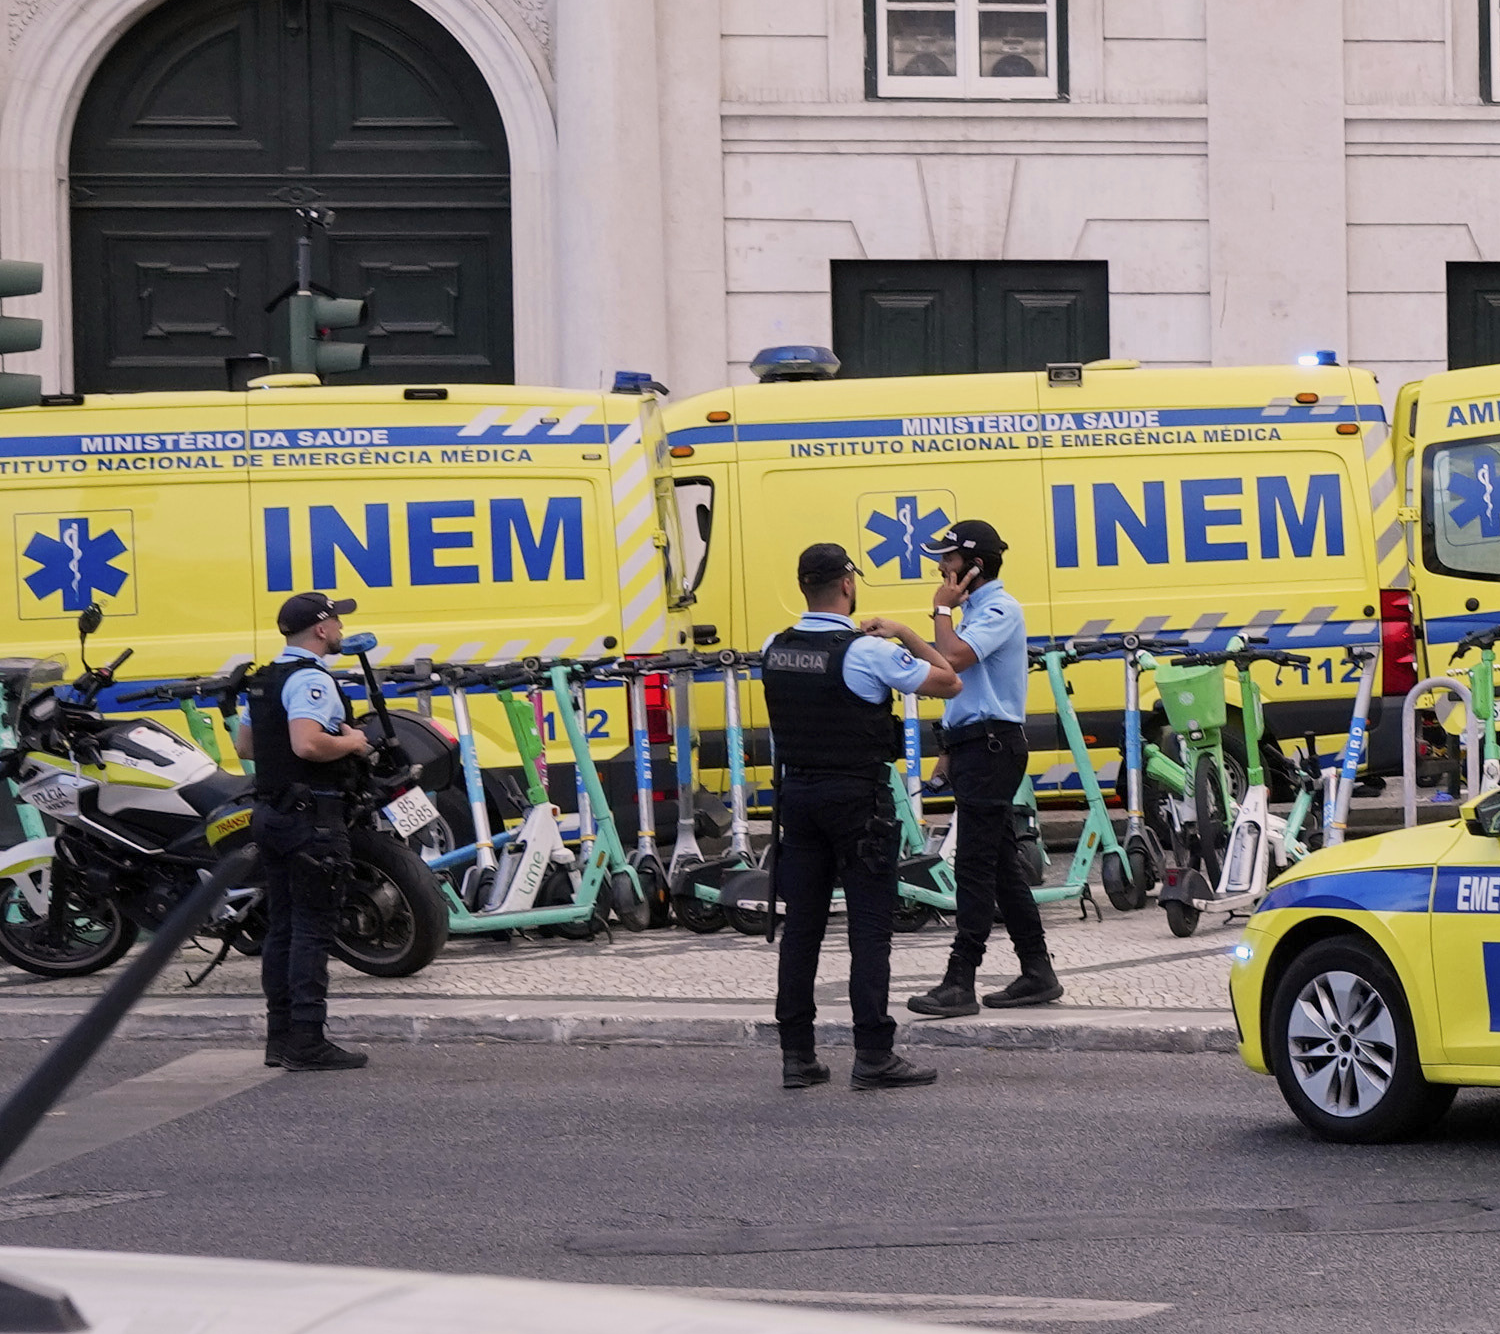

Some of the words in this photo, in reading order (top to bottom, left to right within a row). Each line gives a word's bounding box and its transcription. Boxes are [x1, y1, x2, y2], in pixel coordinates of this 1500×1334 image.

[1042, 413, 1077, 432] DA
[81, 430, 245, 454] MINISTÉRIO
[253, 430, 290, 448] DA
[297, 427, 389, 447] SAÚDE
[790, 440, 904, 458] INSTITUTO
[912, 435, 1020, 454] NACIONAL
[1027, 434, 1054, 449] DE
[1061, 428, 1197, 448] EMERGÊNCIA
[1203, 425, 1282, 443] MÉDICA
[97, 455, 225, 472] NACIONAL
[232, 454, 263, 468] DE
[272, 447, 431, 467] EMERGÊNCIA
[441, 445, 533, 463] MÉDICA
[1051, 473, 1346, 569] INEM
[263, 496, 586, 593] INEM
[544, 709, 610, 741] 12
[641, 737, 653, 780] BIRD
[904, 727, 915, 770] BIRD
[1346, 725, 1363, 770] BIRD
[397, 796, 416, 815] 85
[398, 805, 435, 835] SG85
